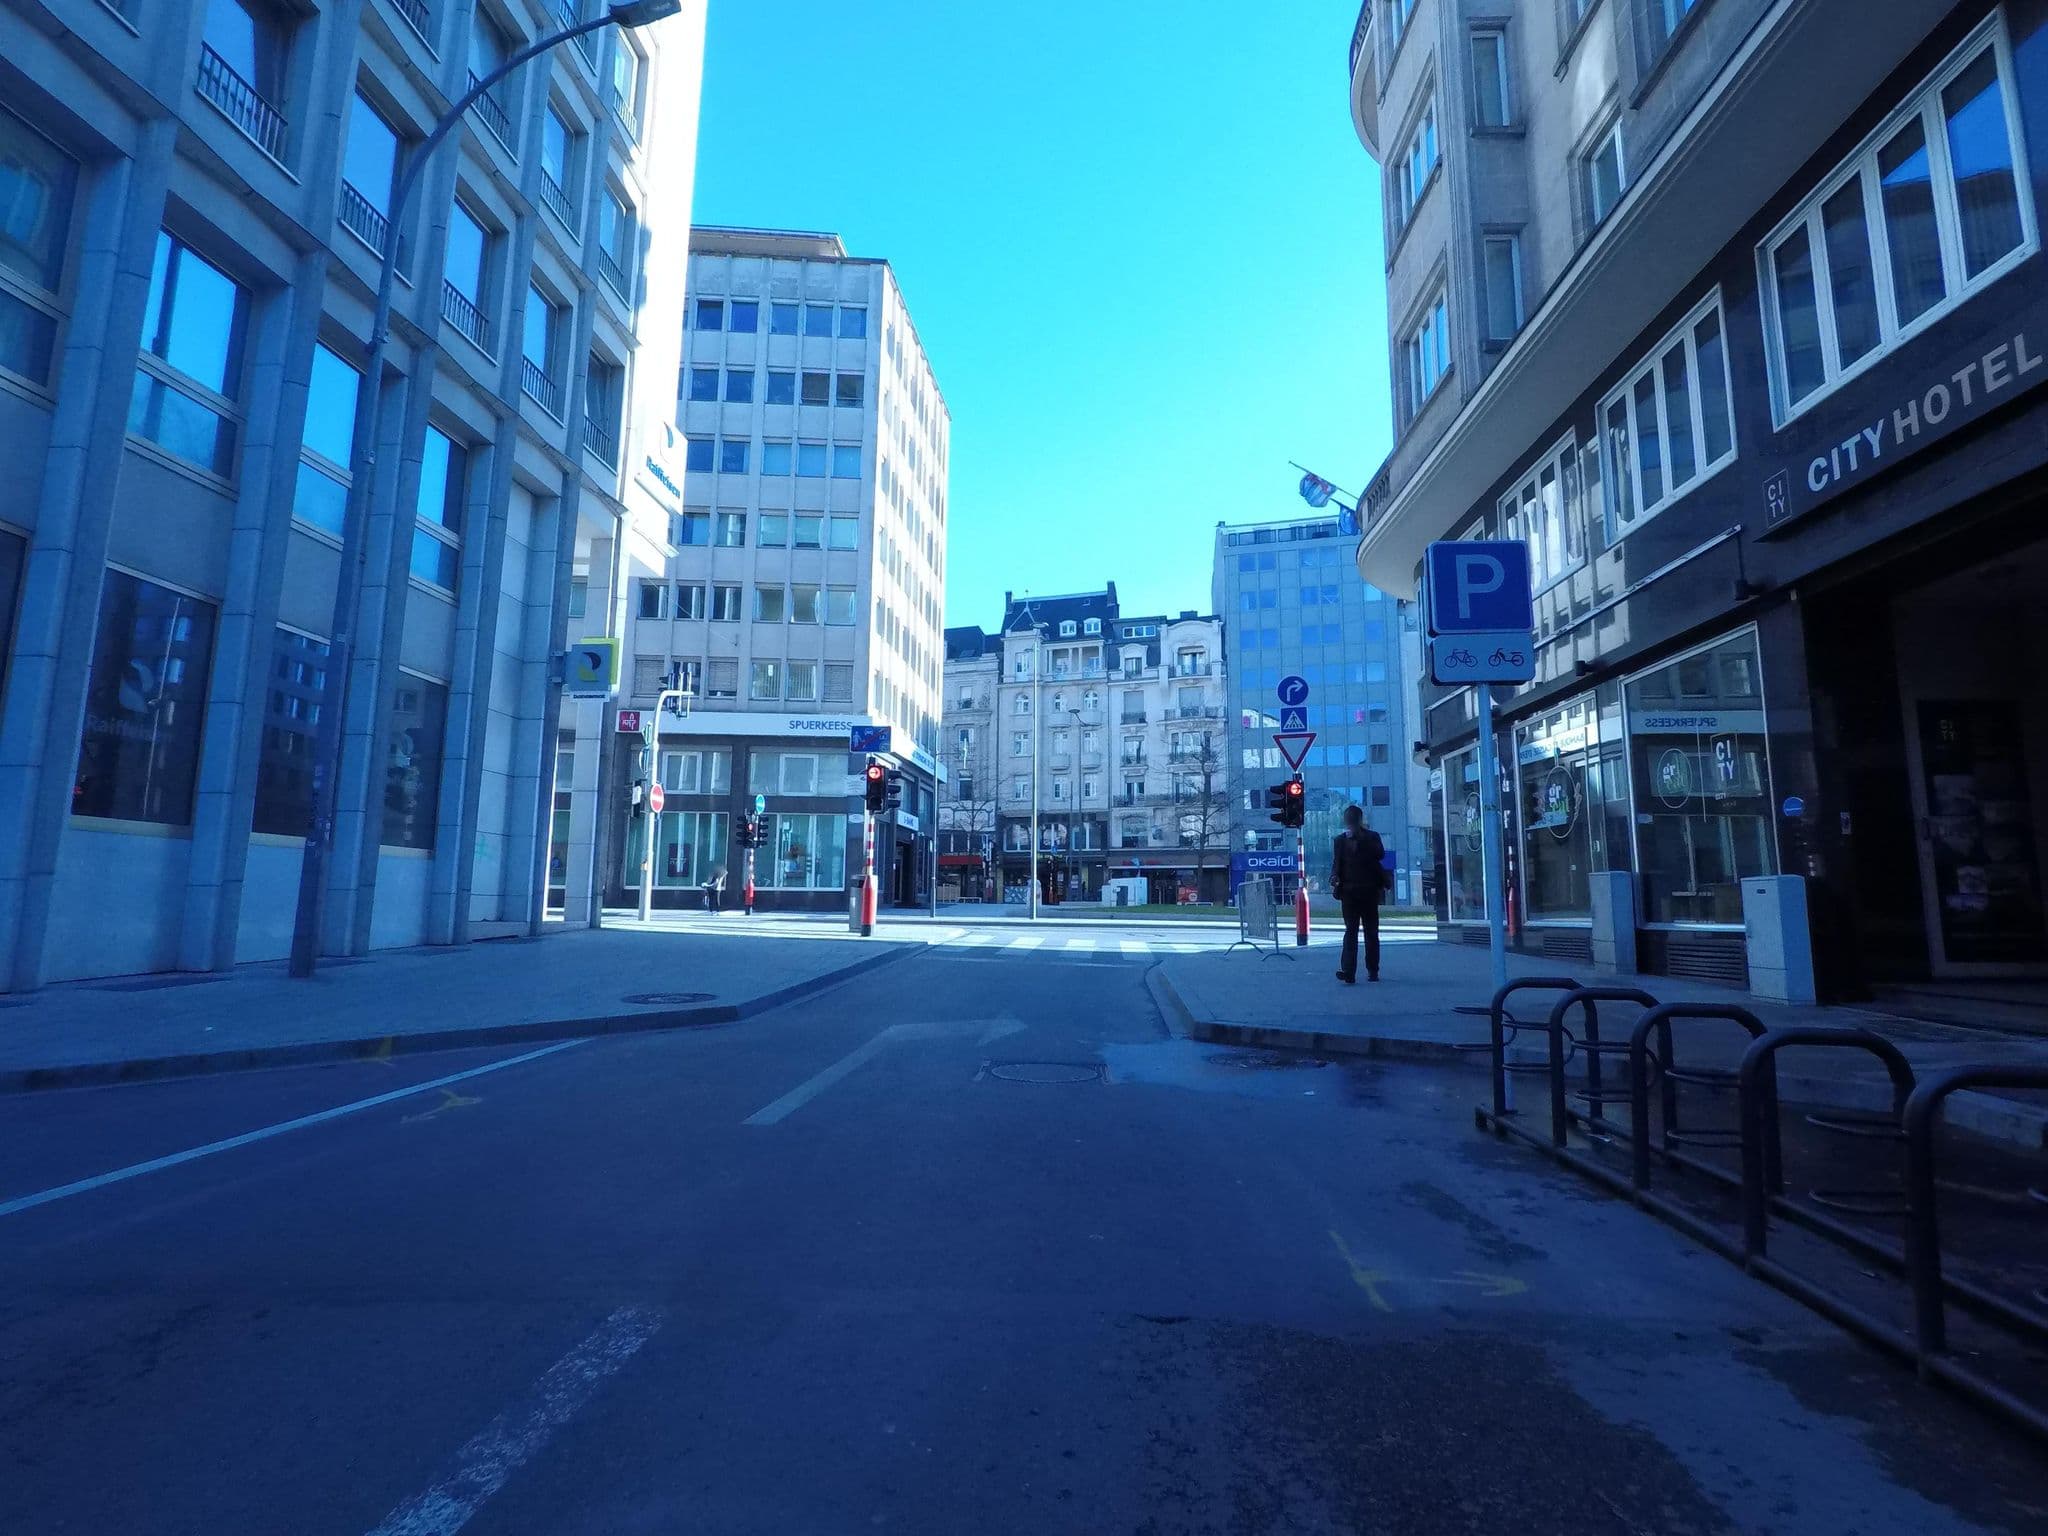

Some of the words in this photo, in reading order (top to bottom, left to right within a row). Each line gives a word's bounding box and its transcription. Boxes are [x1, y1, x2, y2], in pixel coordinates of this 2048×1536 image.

[1807, 419, 1885, 493] CITY
[1892, 333, 2043, 445] HOTEL
[1455, 554, 1505, 619] P
[789, 720, 853, 731] SPUERKEESS
